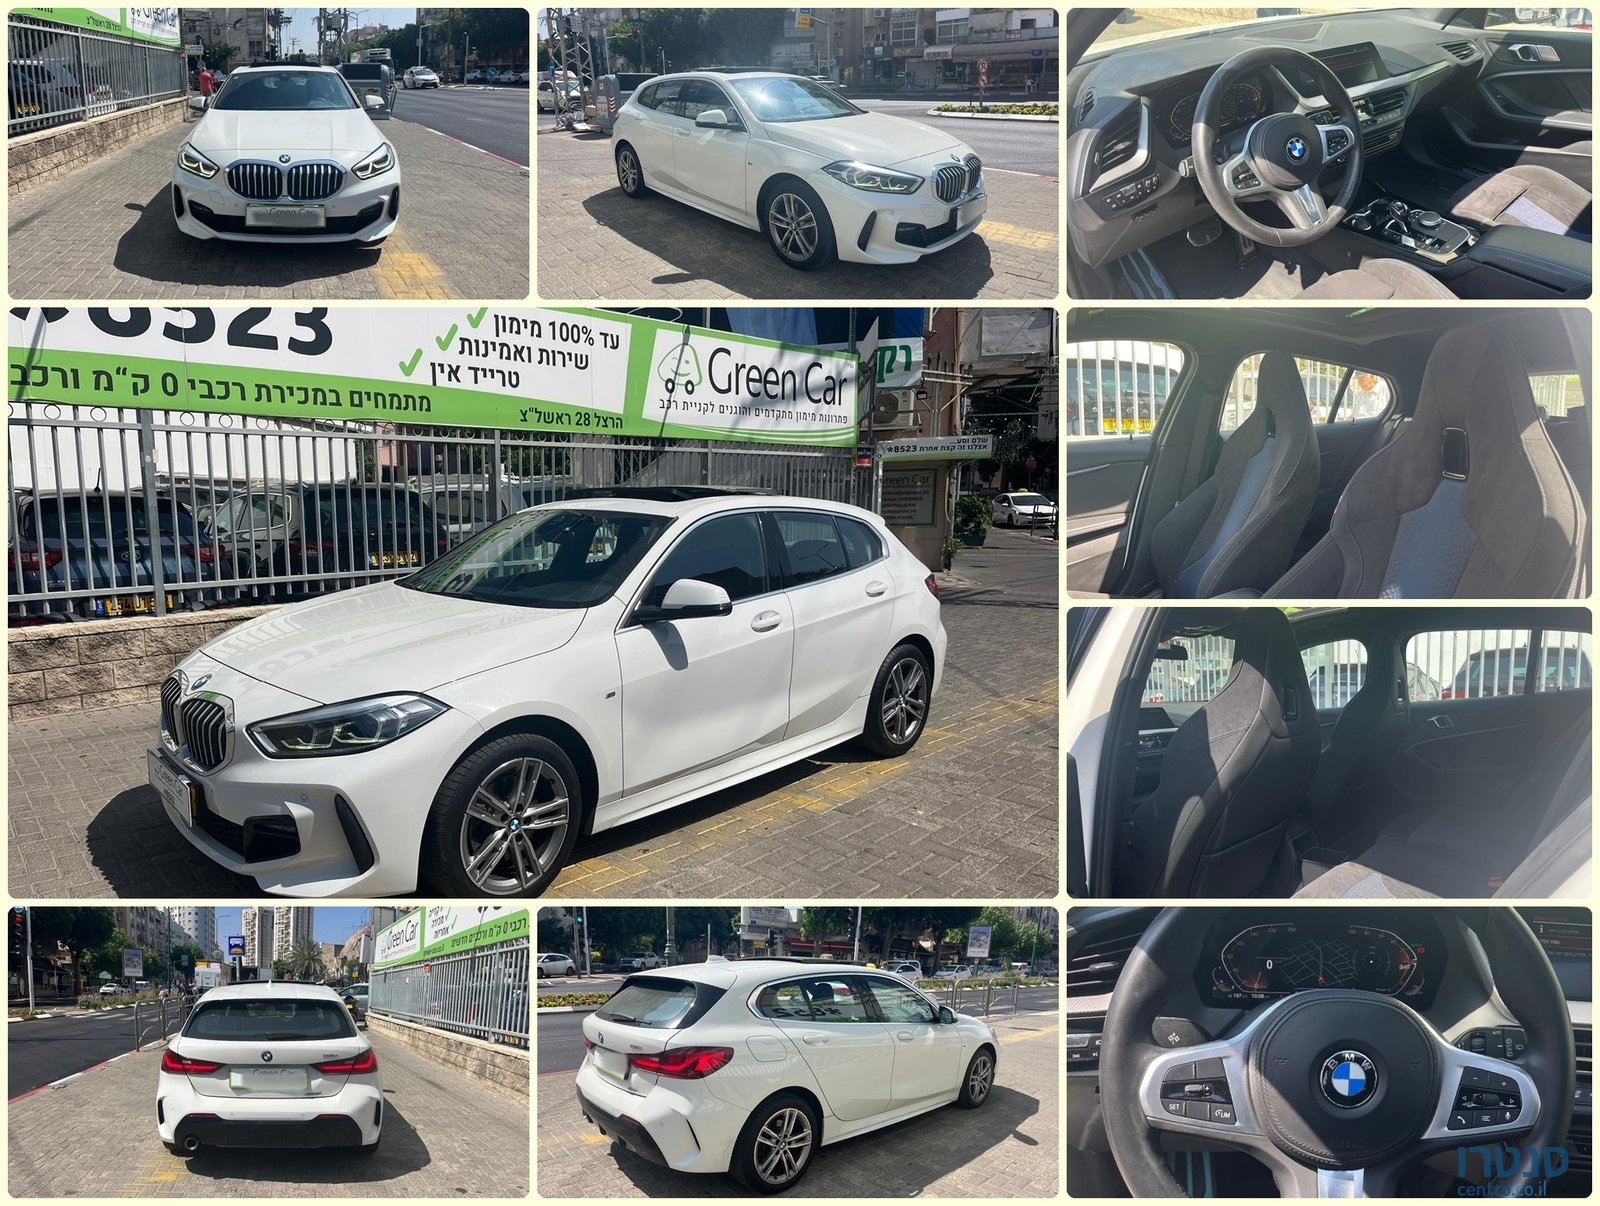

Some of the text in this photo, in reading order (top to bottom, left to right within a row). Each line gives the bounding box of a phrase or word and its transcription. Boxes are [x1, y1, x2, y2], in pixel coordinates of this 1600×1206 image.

[493, 314, 620, 350] עד 100% מימון
[458, 336, 589, 370] שירות ואמינות
[161, 372, 179, 397] 0
[430, 362, 520, 388] טרייד אין
[708, 347, 848, 406] Green Car
[187, 378, 246, 402] רכבי
[254, 383, 343, 407] במכירת
[349, 389, 431, 413] מתמחים
[575, 412, 591, 427] 28
[594, 412, 623, 429] הרצל
[659, 398, 848, 424] פתרונות מימון מתקדמים והוגנים לקניית רכב
[940, 444, 956, 452] קצת
[911, 473, 930, 485] Car
[405, 920, 419, 942] Car
[1266, 959, 1273, 970] 0
